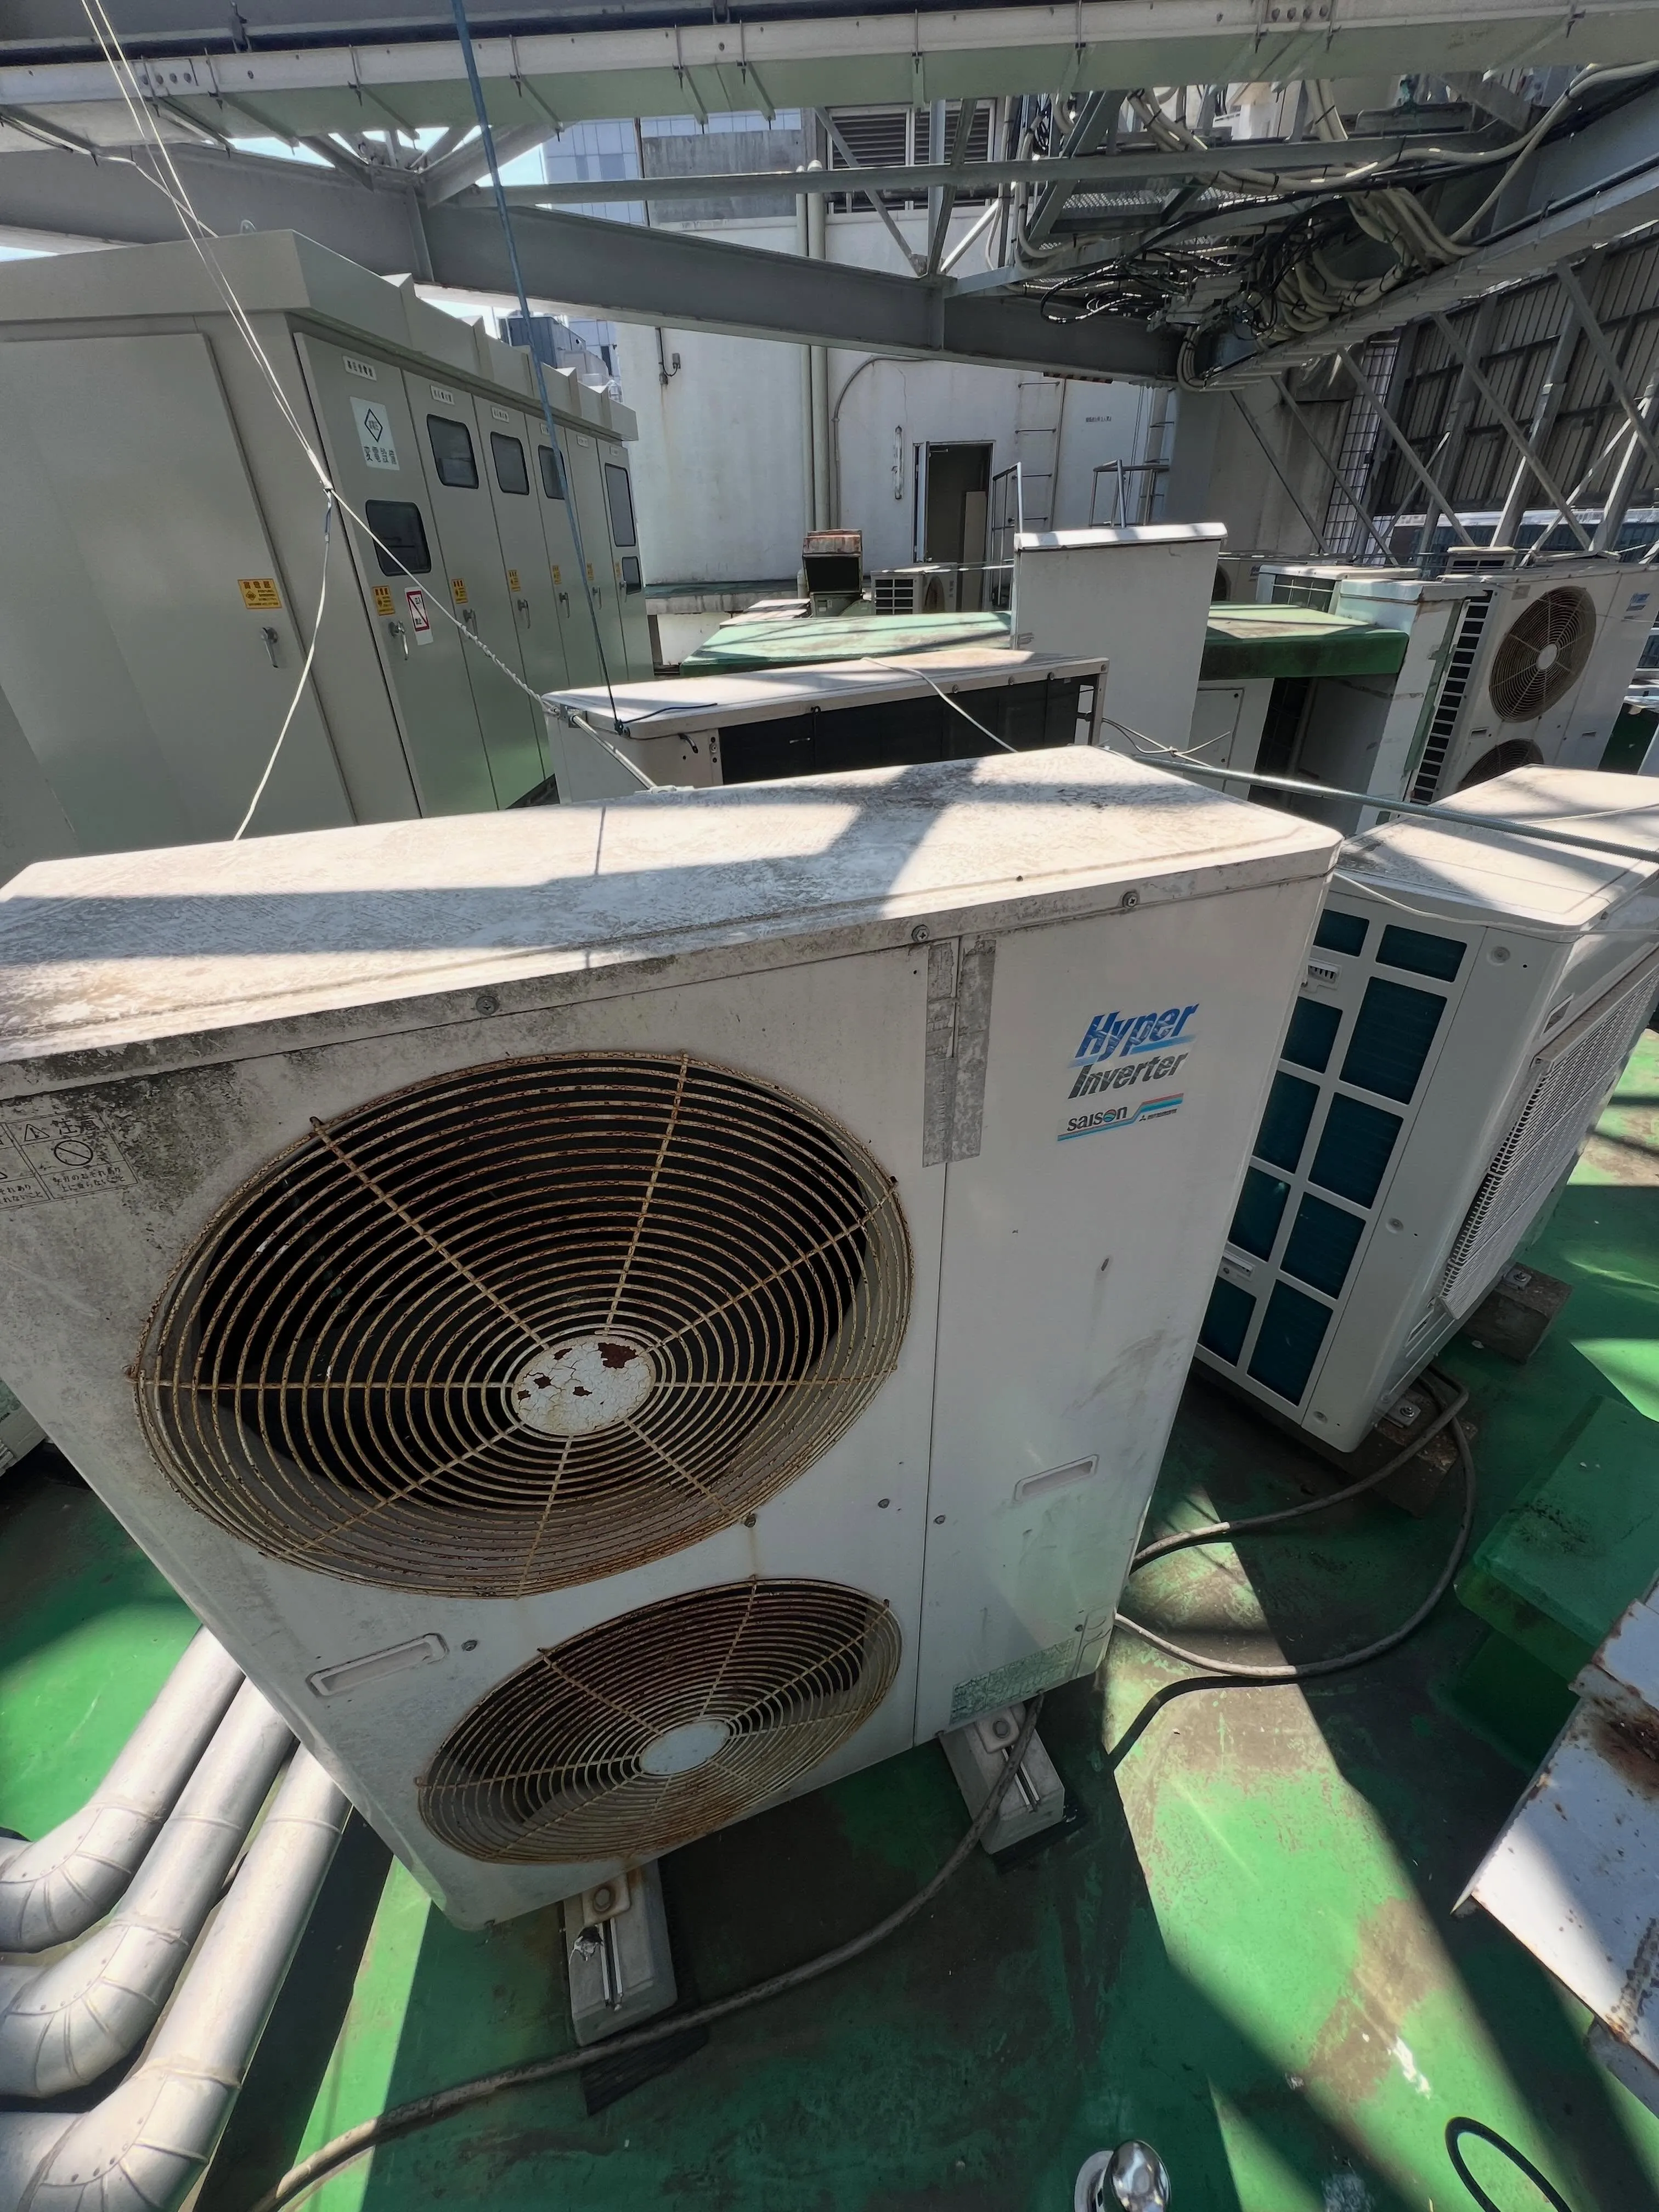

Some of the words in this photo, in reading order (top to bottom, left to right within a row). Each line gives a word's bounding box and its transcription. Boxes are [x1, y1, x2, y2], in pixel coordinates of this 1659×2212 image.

[1075, 1003, 1199, 1062] Hyper
[1068, 1053, 1188, 1099] Inverter
[51, 1113, 100, 1135] 注意
[1067, 1107, 1127, 1131] saison
